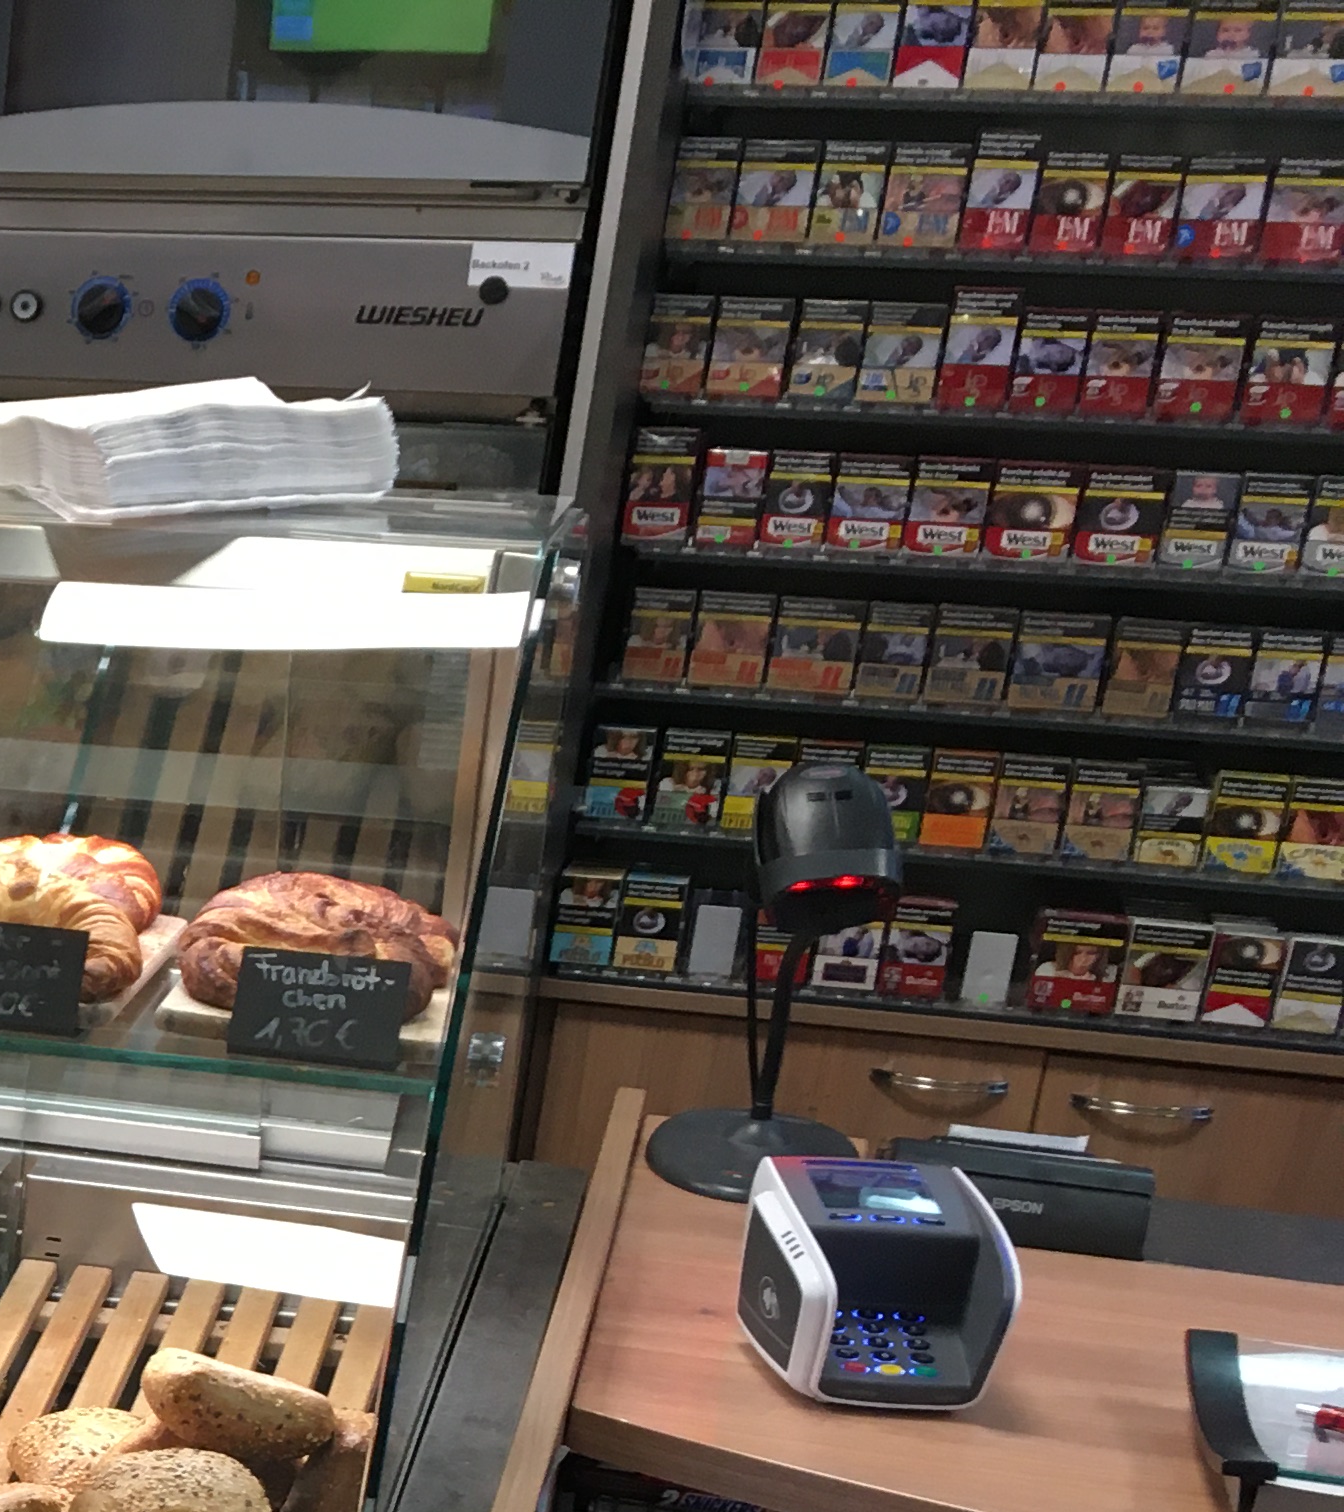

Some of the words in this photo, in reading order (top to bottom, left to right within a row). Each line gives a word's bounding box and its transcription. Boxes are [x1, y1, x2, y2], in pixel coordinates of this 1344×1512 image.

[355, 305, 485, 327] WIESHEU
[636, 509, 676, 523] West
[772, 518, 812, 533] West
[844, 522, 885, 537] West
[923, 526, 964, 541] West
[1006, 533, 1049, 548] West
[1094, 536, 1136, 551] West
[1243, 544, 1285, 559] West
[282, 987, 346, 1011] chen
[992, 1197, 1044, 1215] EPSON
